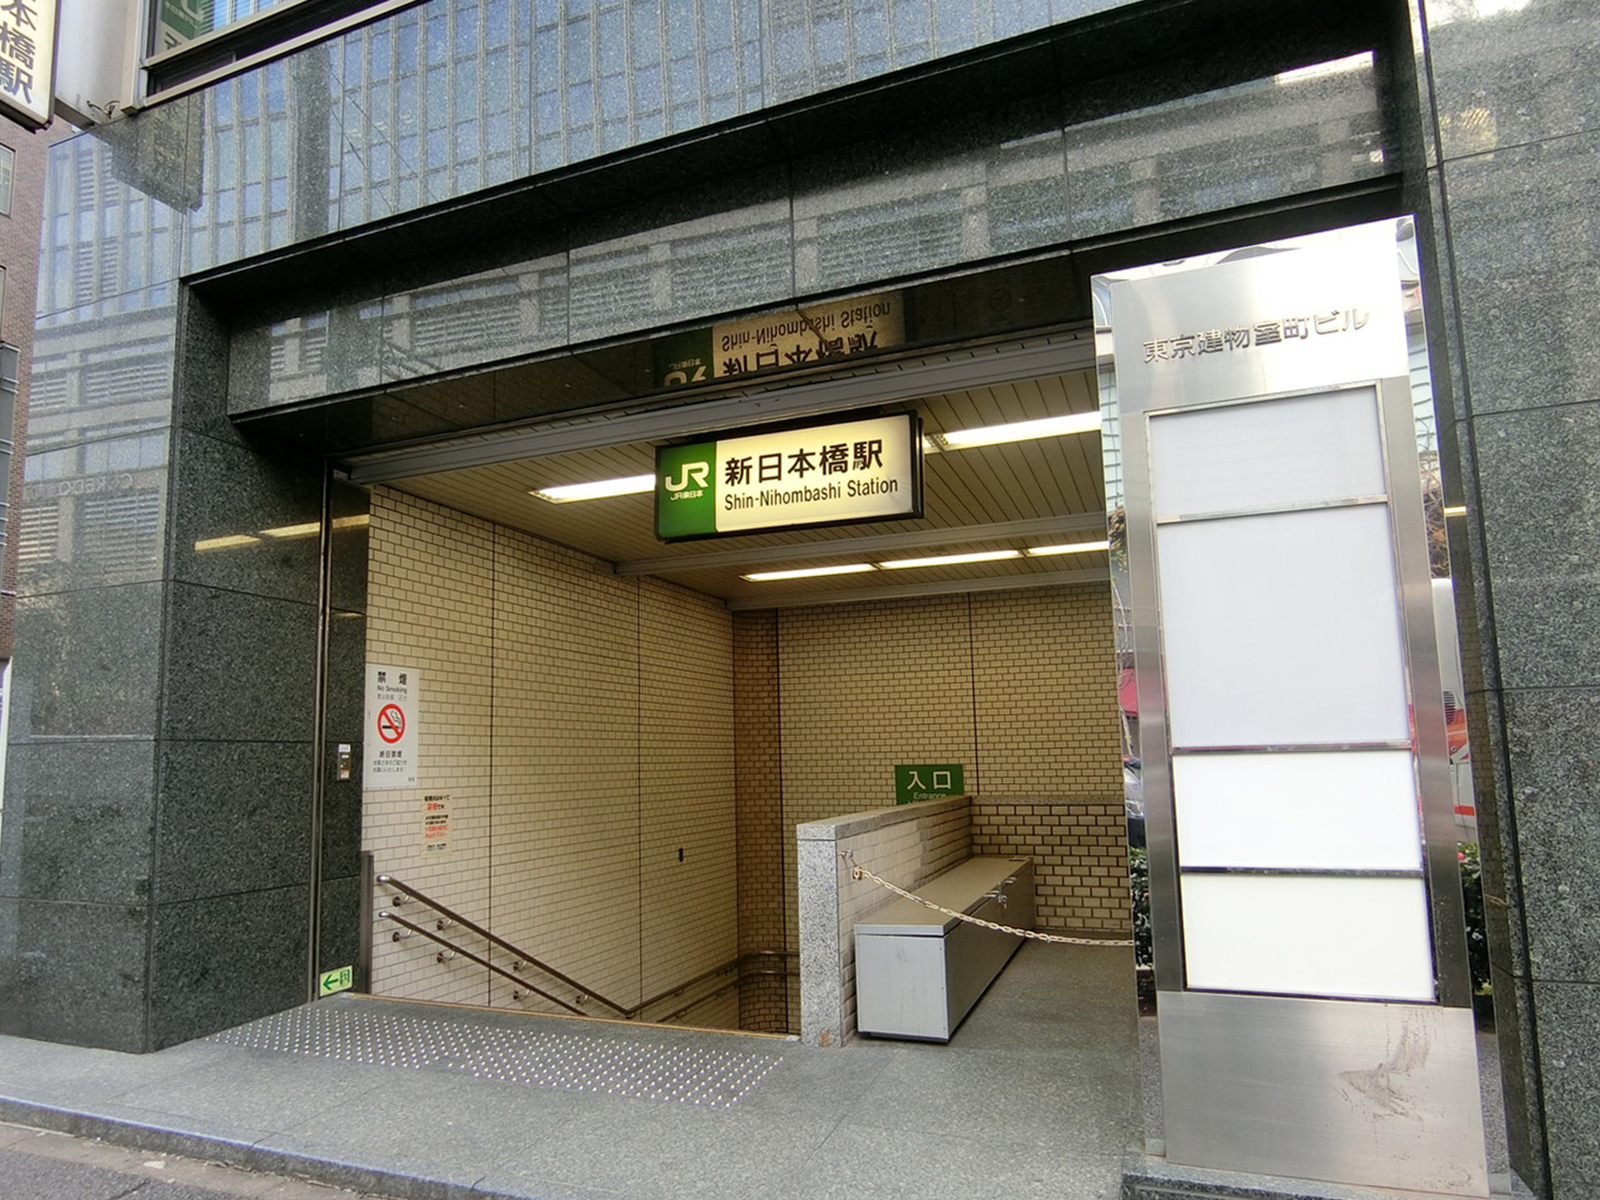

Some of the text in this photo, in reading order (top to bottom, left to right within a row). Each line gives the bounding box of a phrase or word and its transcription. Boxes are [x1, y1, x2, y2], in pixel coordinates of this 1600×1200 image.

[1143, 308, 1370, 364] 東京建物室町ビル
[665, 461, 710, 491] JR
[724, 439, 883, 487] 新日本橋駅
[724, 477, 899, 511] Shin-Nihombashi Station
[386, 685, 407, 695] Smoking
[906, 771, 952, 790] 入口
